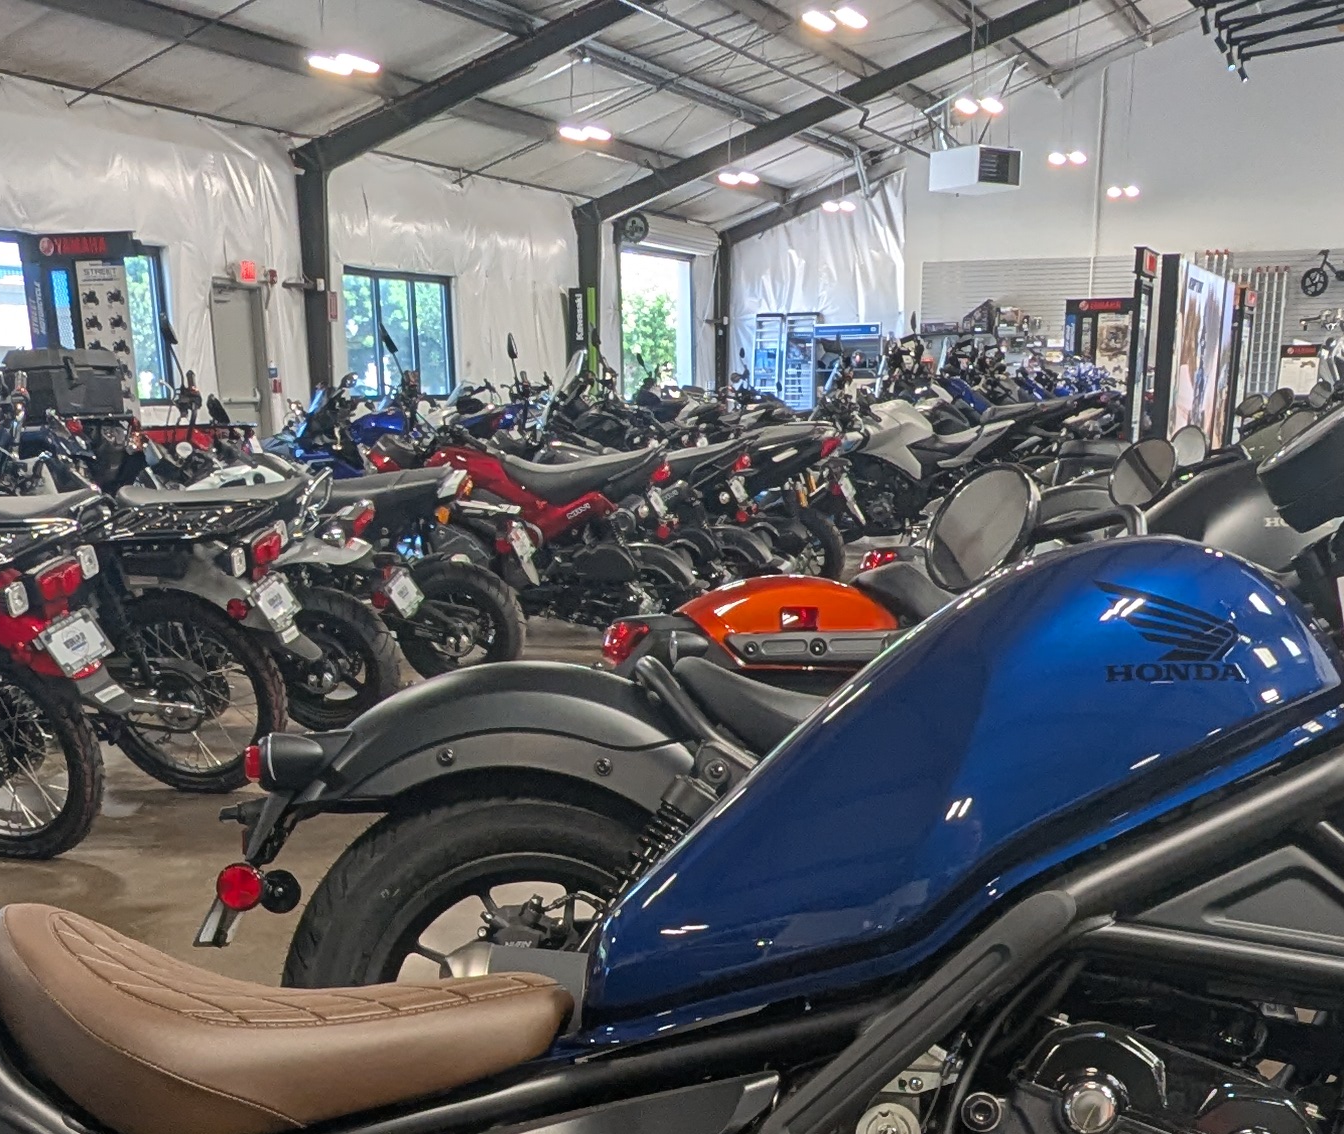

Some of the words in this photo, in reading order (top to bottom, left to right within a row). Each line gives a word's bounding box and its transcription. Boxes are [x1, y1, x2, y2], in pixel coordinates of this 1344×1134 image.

[54, 236, 106, 254] YAMAHA
[83, 268, 117, 276] STREET
[575, 293, 584, 341] Kawasaki
[1106, 663, 1248, 682] HONDA
